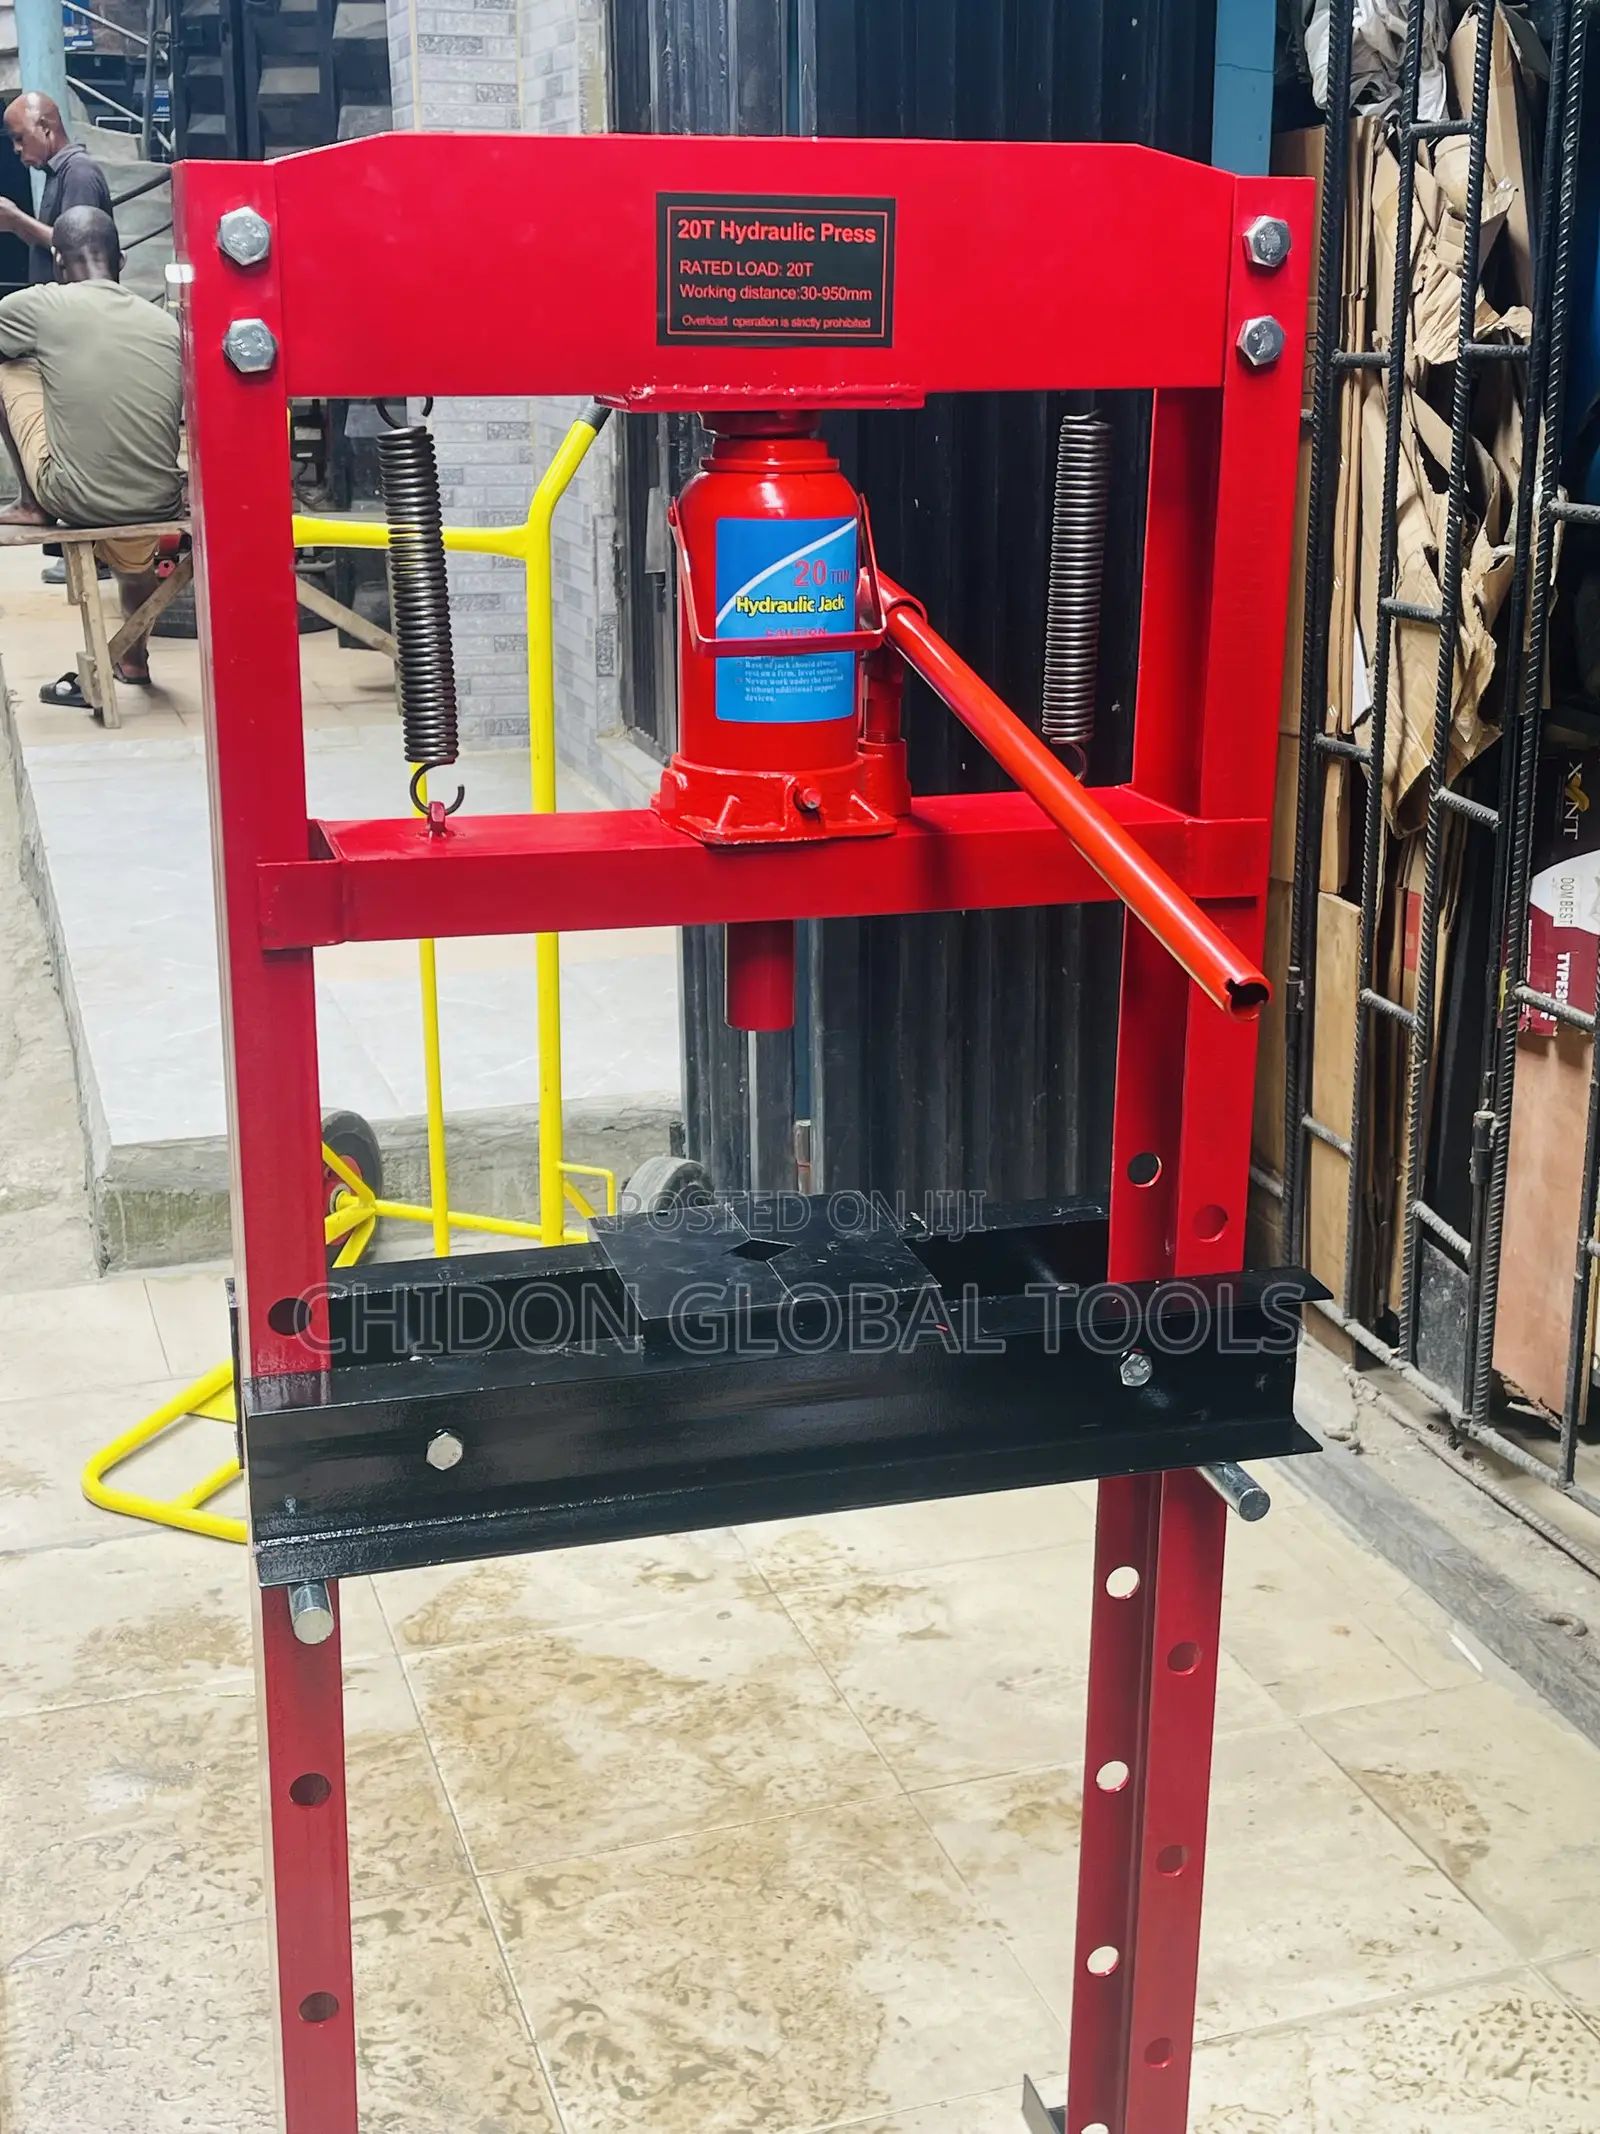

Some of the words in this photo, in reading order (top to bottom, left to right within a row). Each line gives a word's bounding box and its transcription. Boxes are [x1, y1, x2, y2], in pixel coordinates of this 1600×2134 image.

[677, 219, 715, 240] 20T
[720, 220, 815, 244] Hydraulic
[821, 223, 877, 243] Press
[679, 260, 732, 276] RATED
[737, 261, 783, 277] LOAD:
[786, 262, 814, 277] 20T
[679, 284, 736, 302] Working
[682, 315, 728, 327] Overload
[733, 317, 778, 328] operation
[781, 317, 789, 328] is
[791, 317, 821, 330] strictly
[823, 318, 871, 329] prohibited
[793, 560, 828, 587] 20
[831, 569, 851, 584] TON
[736, 595, 816, 618] Hydraulic
[818, 593, 845, 613] Jack
[1559, 900, 1574, 925] BEST
[1555, 952, 1571, 1005] TYPE3
